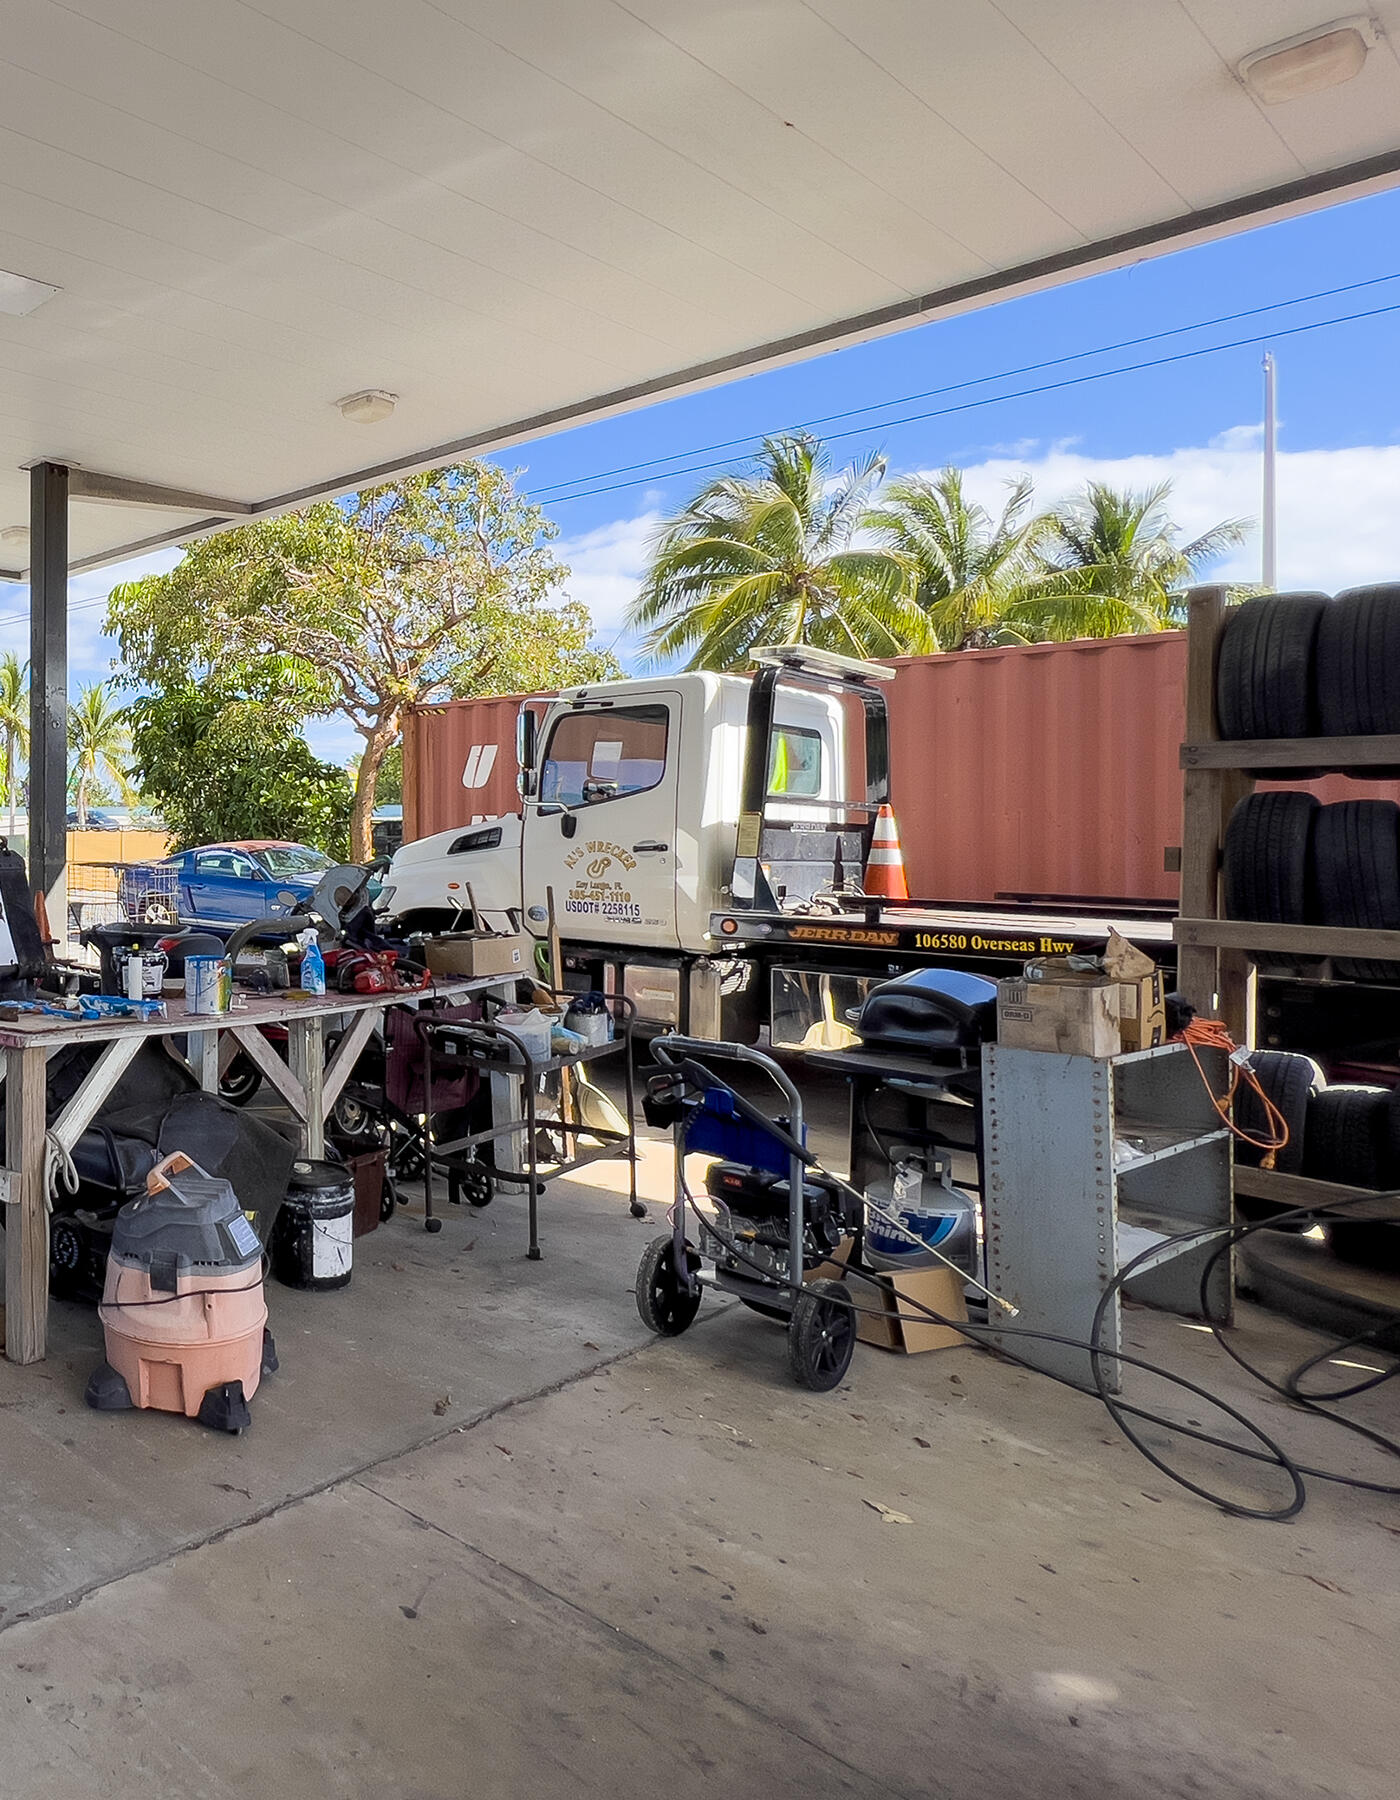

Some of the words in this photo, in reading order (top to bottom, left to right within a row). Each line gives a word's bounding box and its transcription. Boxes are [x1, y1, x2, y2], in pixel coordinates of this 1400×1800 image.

[564, 847, 584, 870] AL'S
[585, 841, 637, 871] WRECKER
[565, 901, 599, 913] USDOT#
[602, 903, 640, 916] 2258115
[915, 933, 967, 949] 106580
[971, 935, 1035, 952] Overseas
